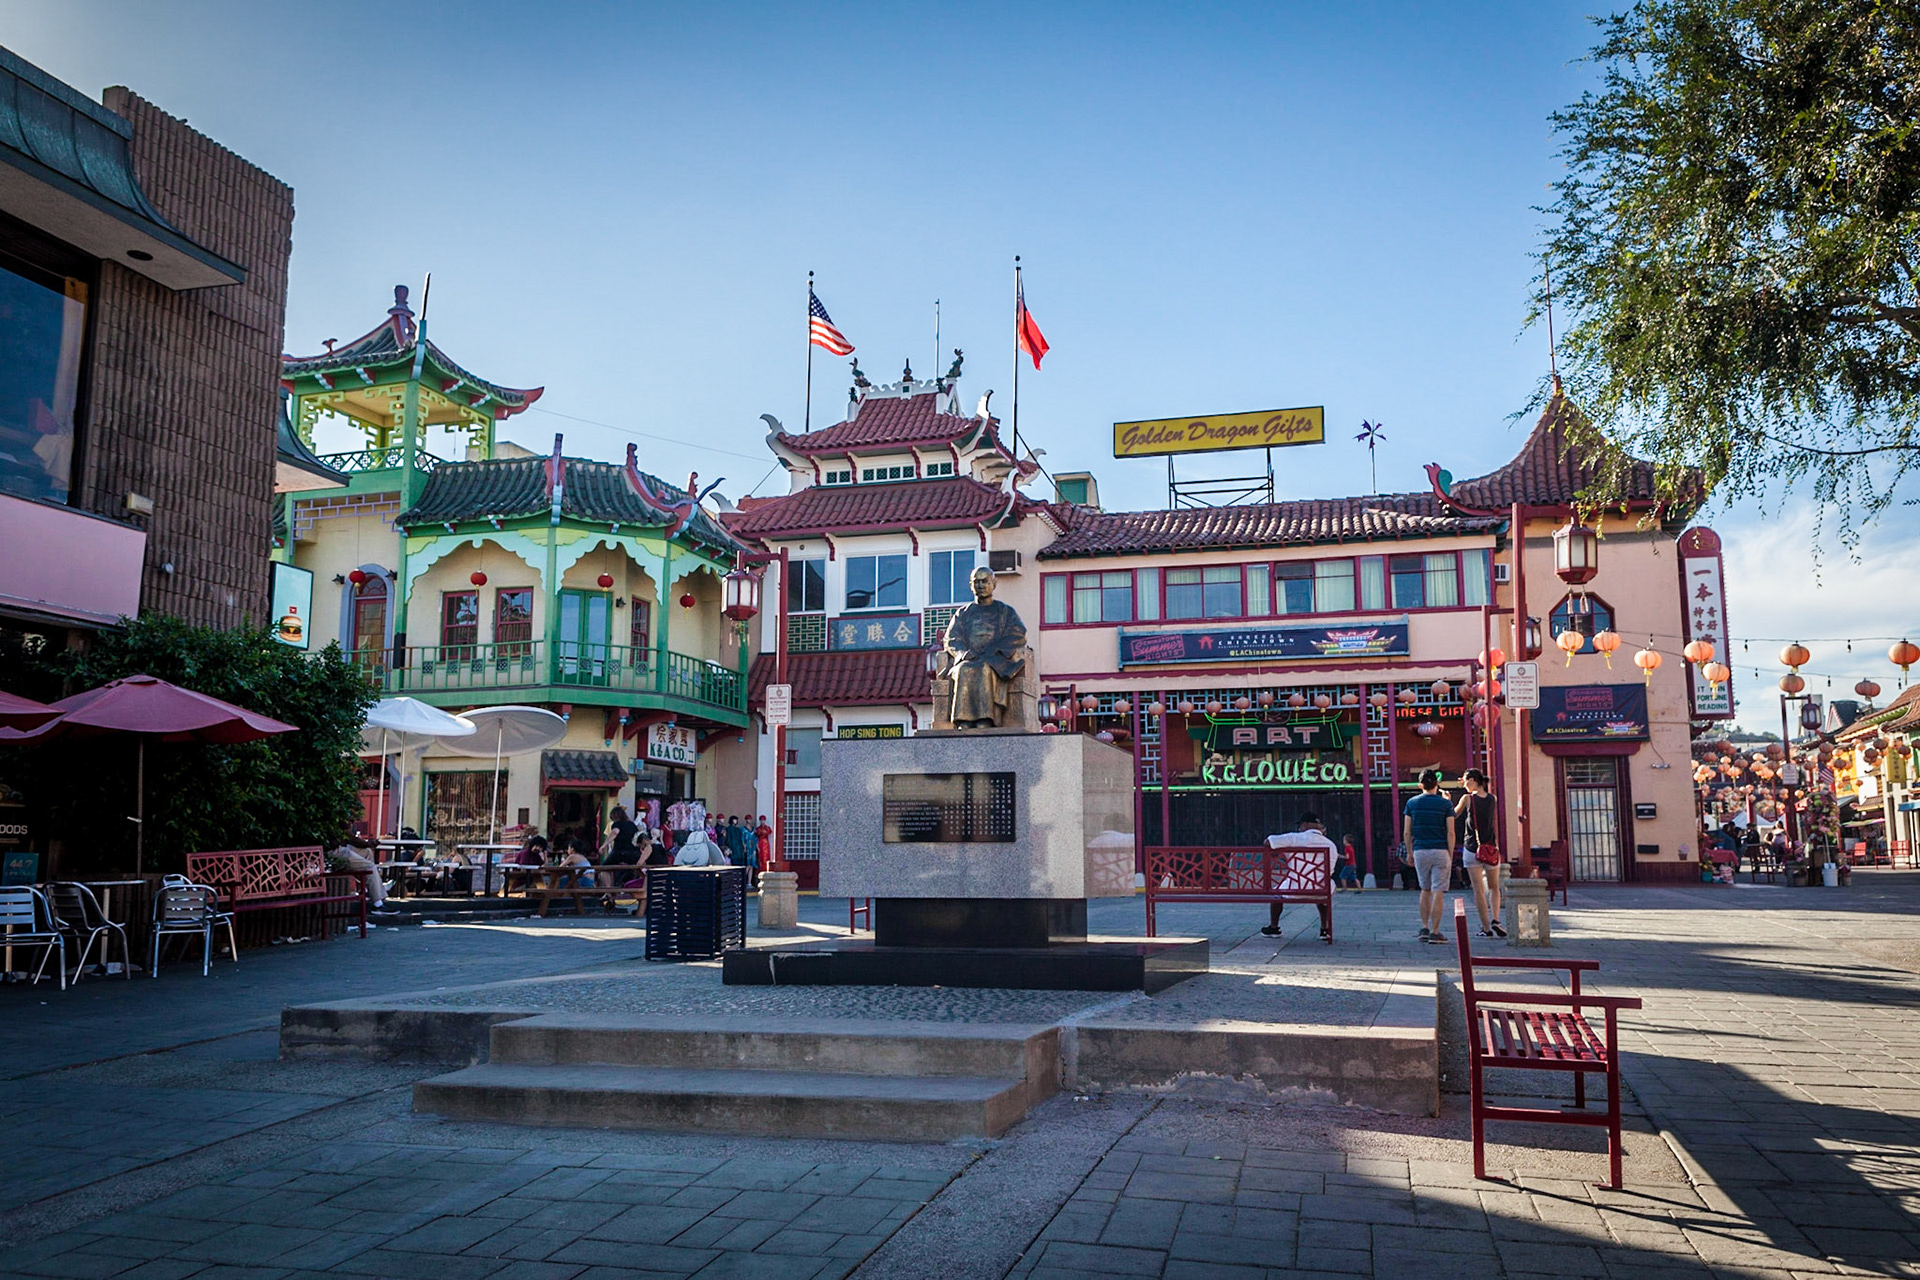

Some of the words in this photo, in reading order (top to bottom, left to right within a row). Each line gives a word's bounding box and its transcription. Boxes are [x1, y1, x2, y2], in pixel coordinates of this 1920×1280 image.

[1121, 425, 1184, 452] Golden
[1188, 421, 1259, 444] Dragon
[1263, 415, 1314, 441] Gifts
[1135, 639, 1182, 656] Summer
[1218, 637, 1295, 646] CHINATOWN
[1145, 650, 1179, 660] NIGHTS
[839, 728, 856, 738] HOP
[857, 728, 877, 738] SING
[878, 727, 902, 737] TONG
[1233, 726, 1320, 745] ART
[650, 742, 656, 757] K
[663, 746, 671, 759] A
[1243, 758, 1319, 784] LOUIE
